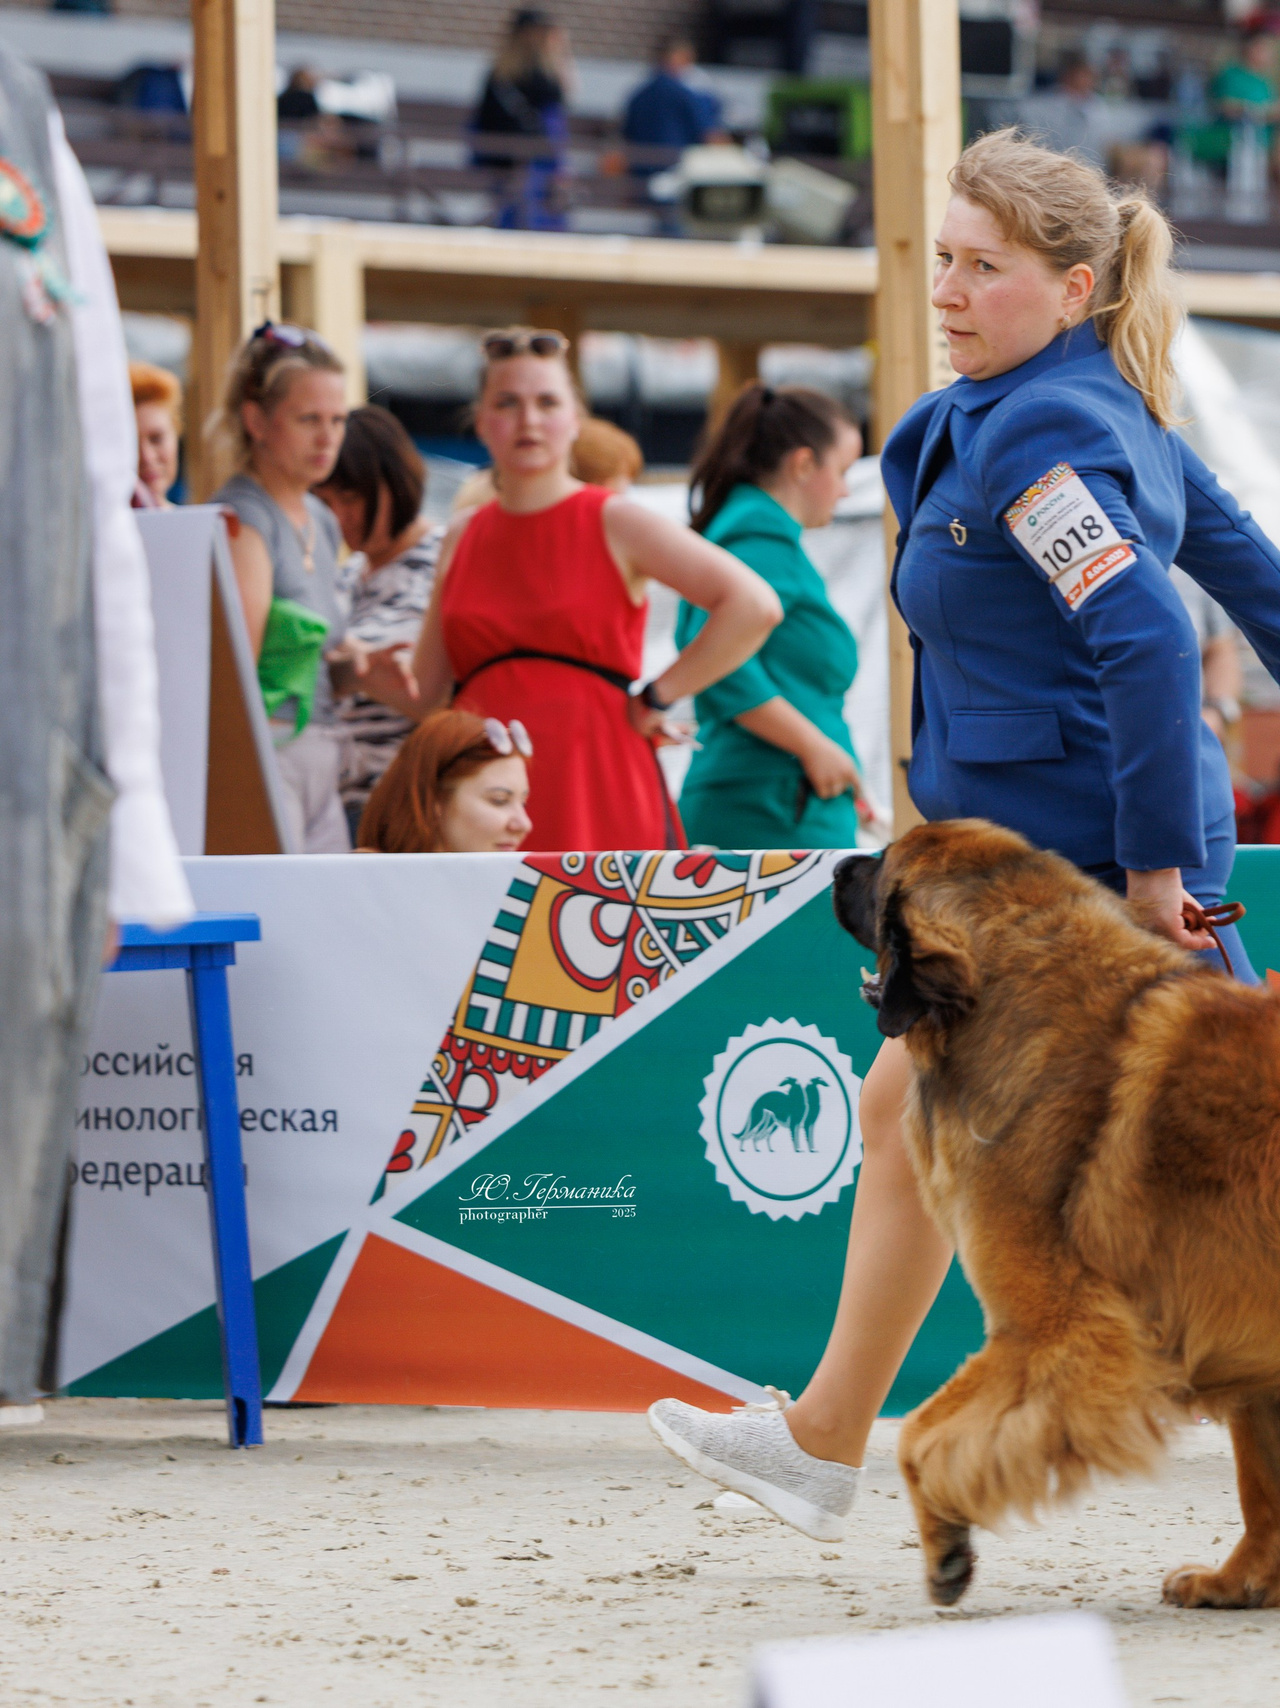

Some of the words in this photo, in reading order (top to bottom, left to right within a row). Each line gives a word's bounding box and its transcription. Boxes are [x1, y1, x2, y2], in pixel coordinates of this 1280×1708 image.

[1042, 514, 1104, 571] 1018
[80, 1043, 254, 1076] ссийся
[74, 1107, 338, 1133] инологеская
[69, 1160, 248, 1197] едерац
